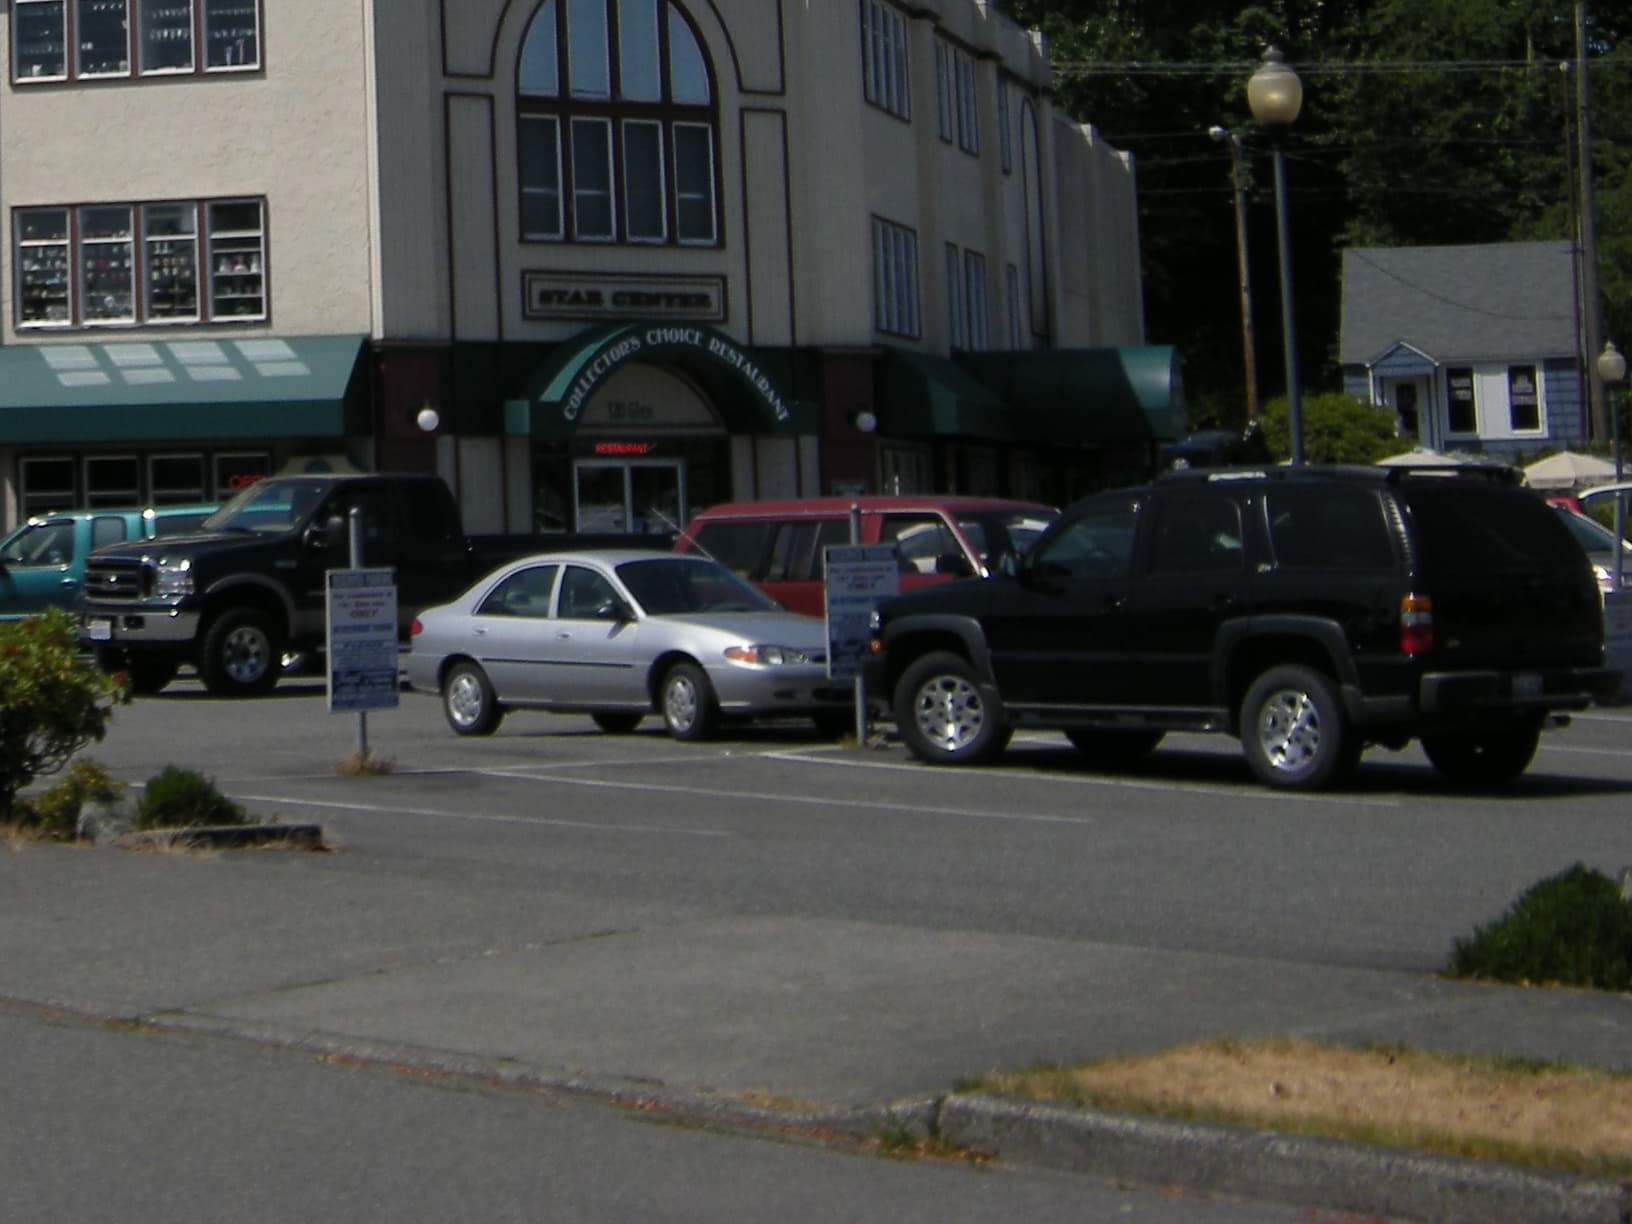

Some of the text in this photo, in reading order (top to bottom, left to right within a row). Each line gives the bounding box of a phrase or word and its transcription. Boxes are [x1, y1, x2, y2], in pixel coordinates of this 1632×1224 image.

[539, 289, 712, 308] STAR CENTER
[645, 327, 704, 347] CHOICE
[708, 335, 791, 422] RESTAURANT
